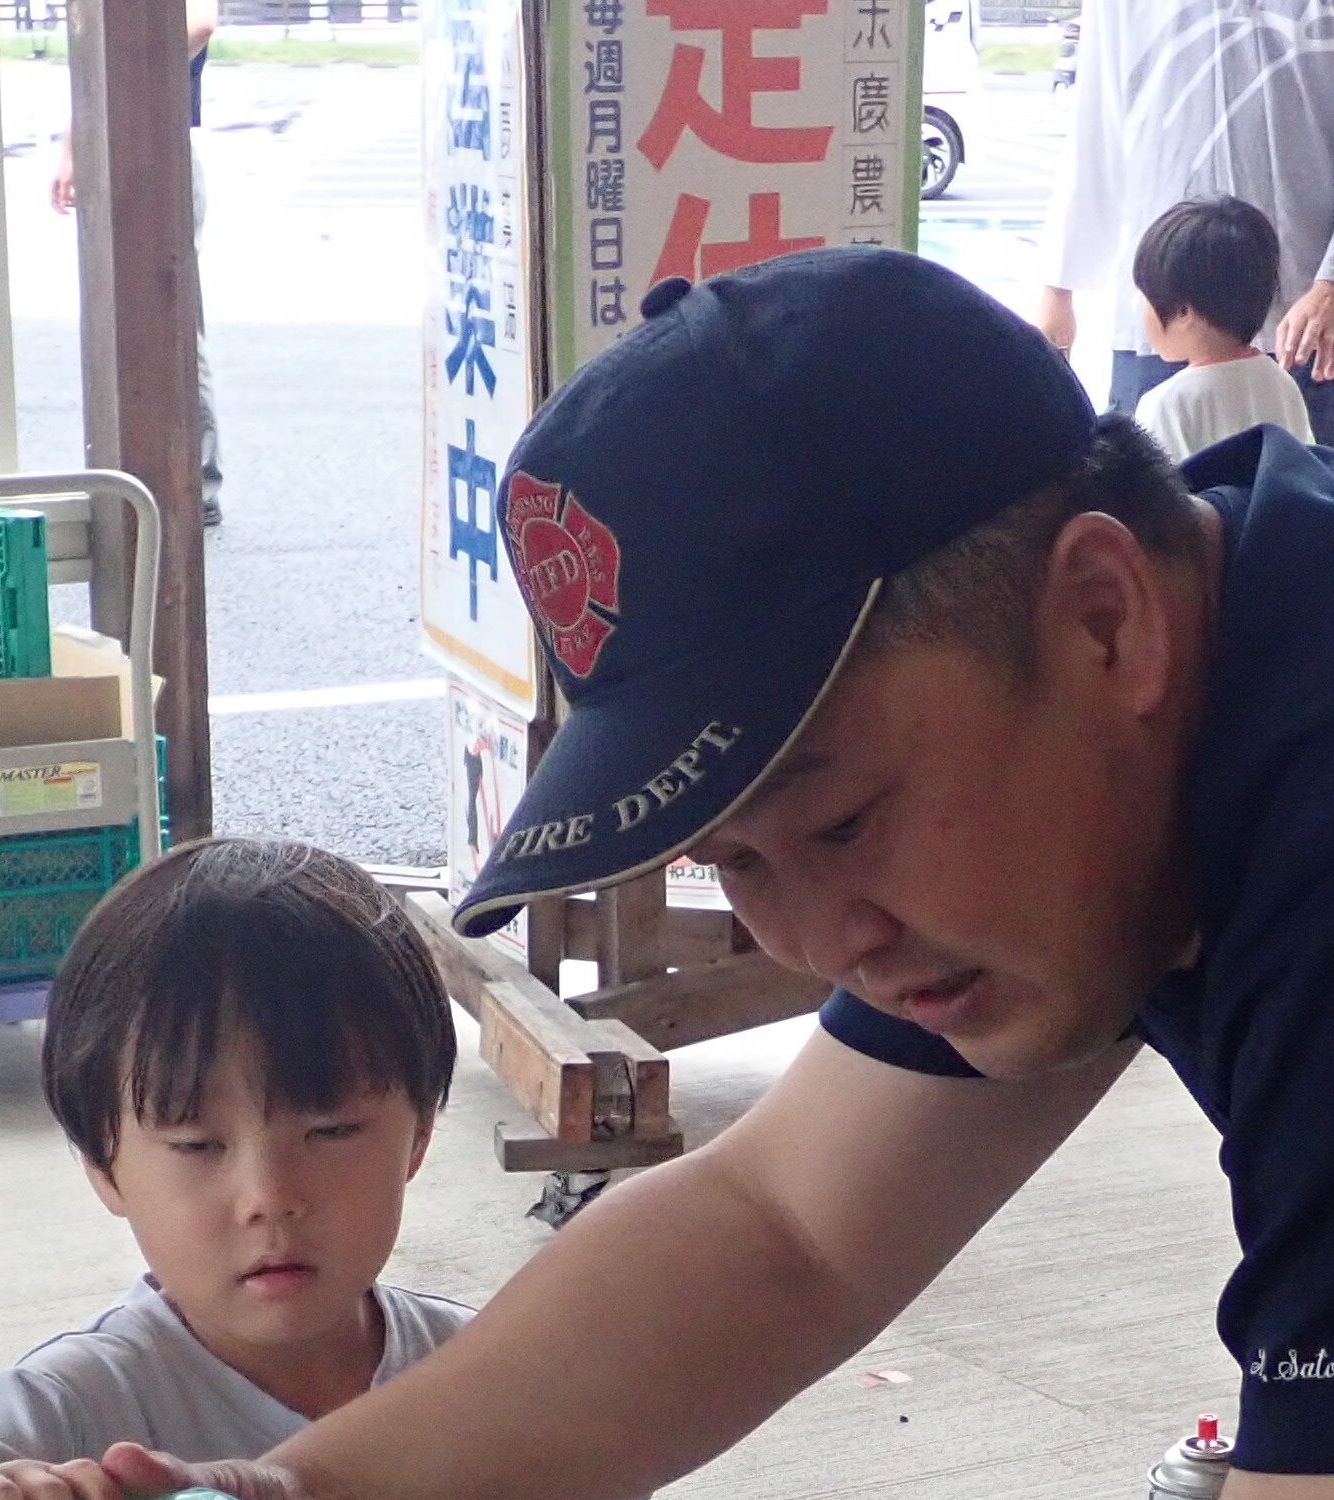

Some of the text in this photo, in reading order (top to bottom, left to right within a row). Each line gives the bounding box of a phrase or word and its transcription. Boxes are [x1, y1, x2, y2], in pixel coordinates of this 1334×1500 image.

[0, 765, 62, 784] MASTER
[500, 812, 595, 863] FIRE
[612, 719, 743, 832] DEPT.
